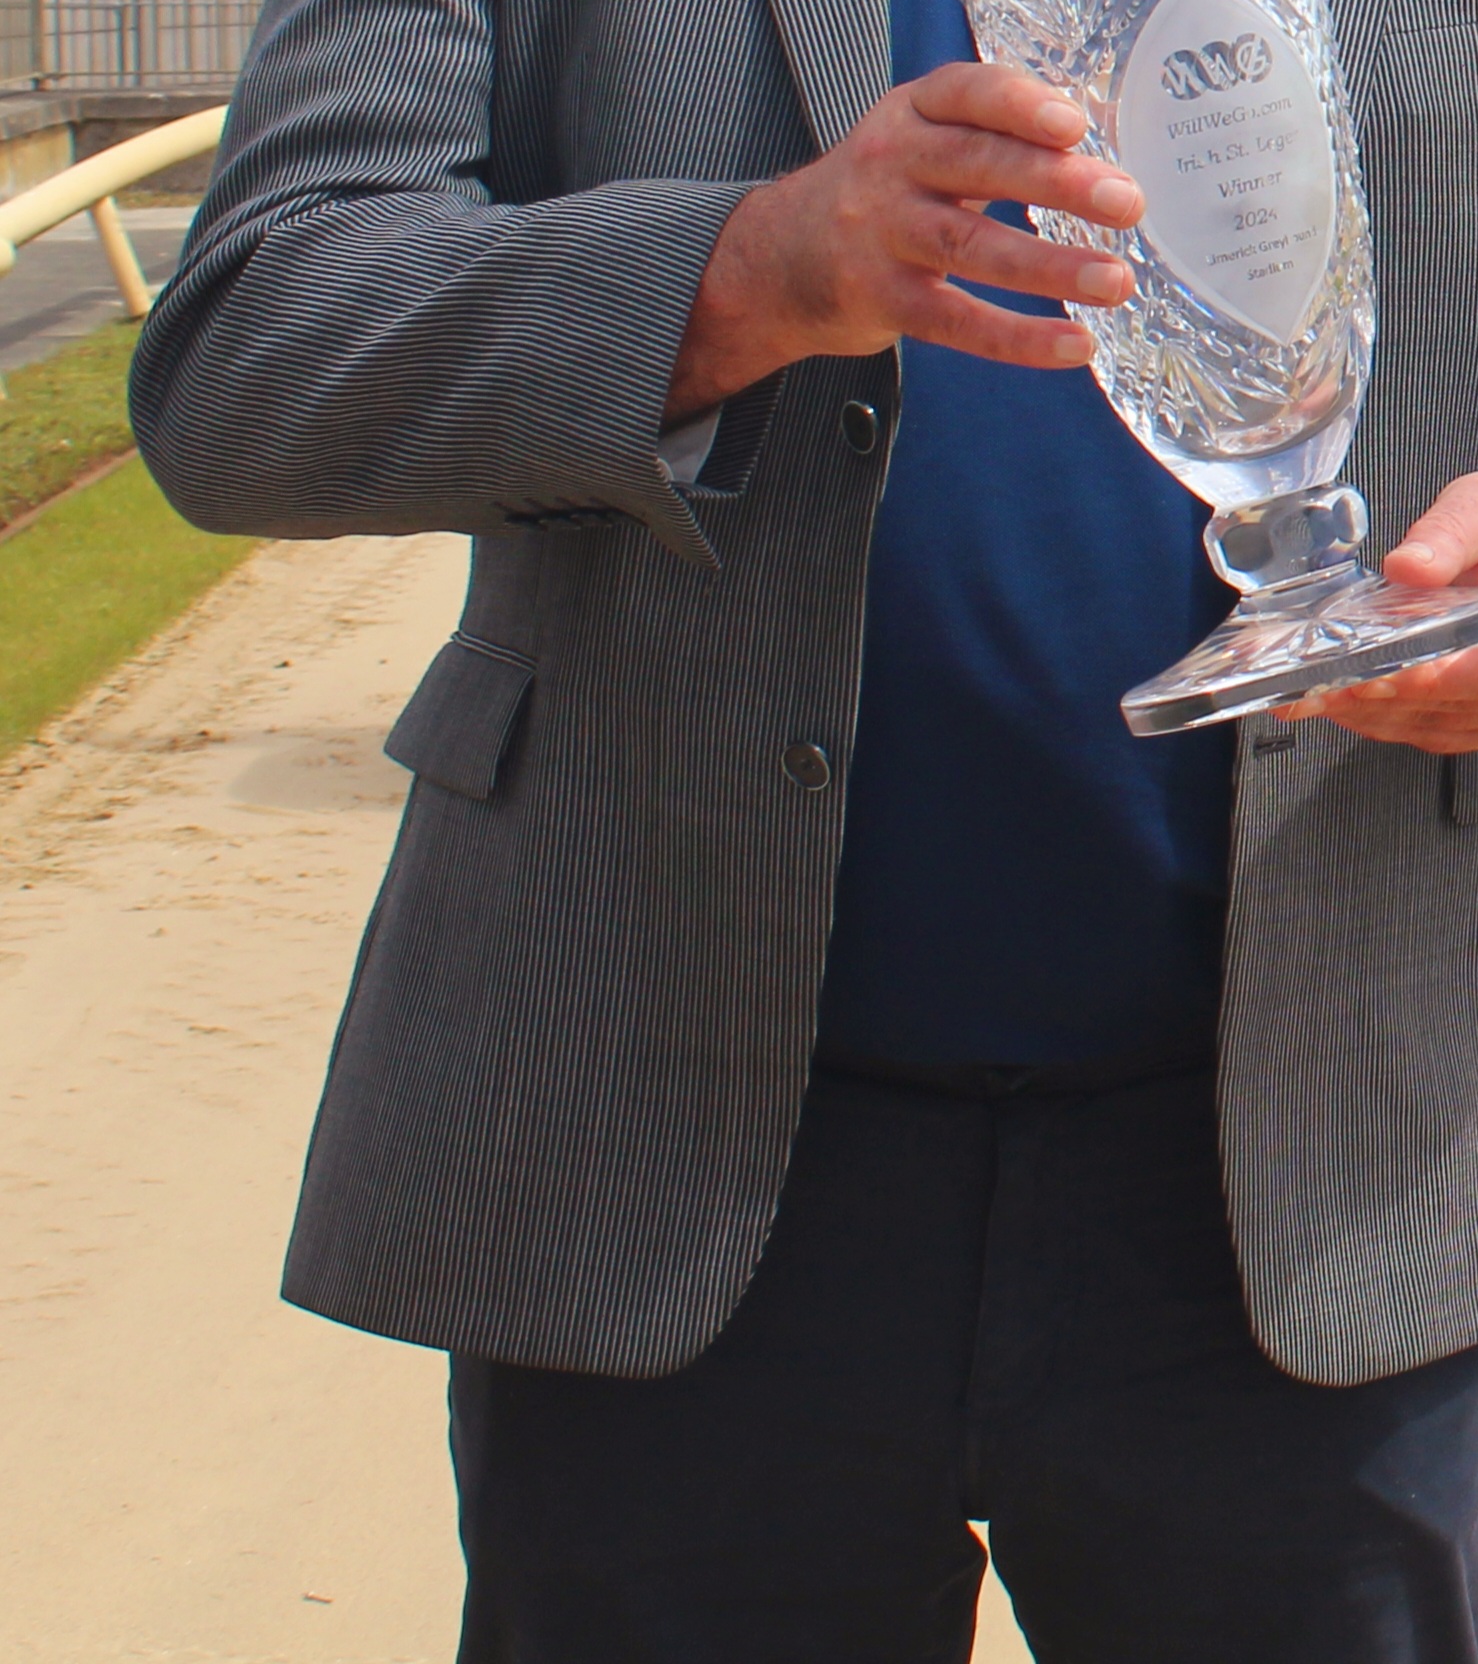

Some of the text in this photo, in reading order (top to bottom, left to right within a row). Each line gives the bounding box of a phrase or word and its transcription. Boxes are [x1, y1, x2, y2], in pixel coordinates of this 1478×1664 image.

[1176, 149, 1222, 174] Irih
[1256, 130, 1300, 153] Lege
[1217, 171, 1284, 198] Winner
